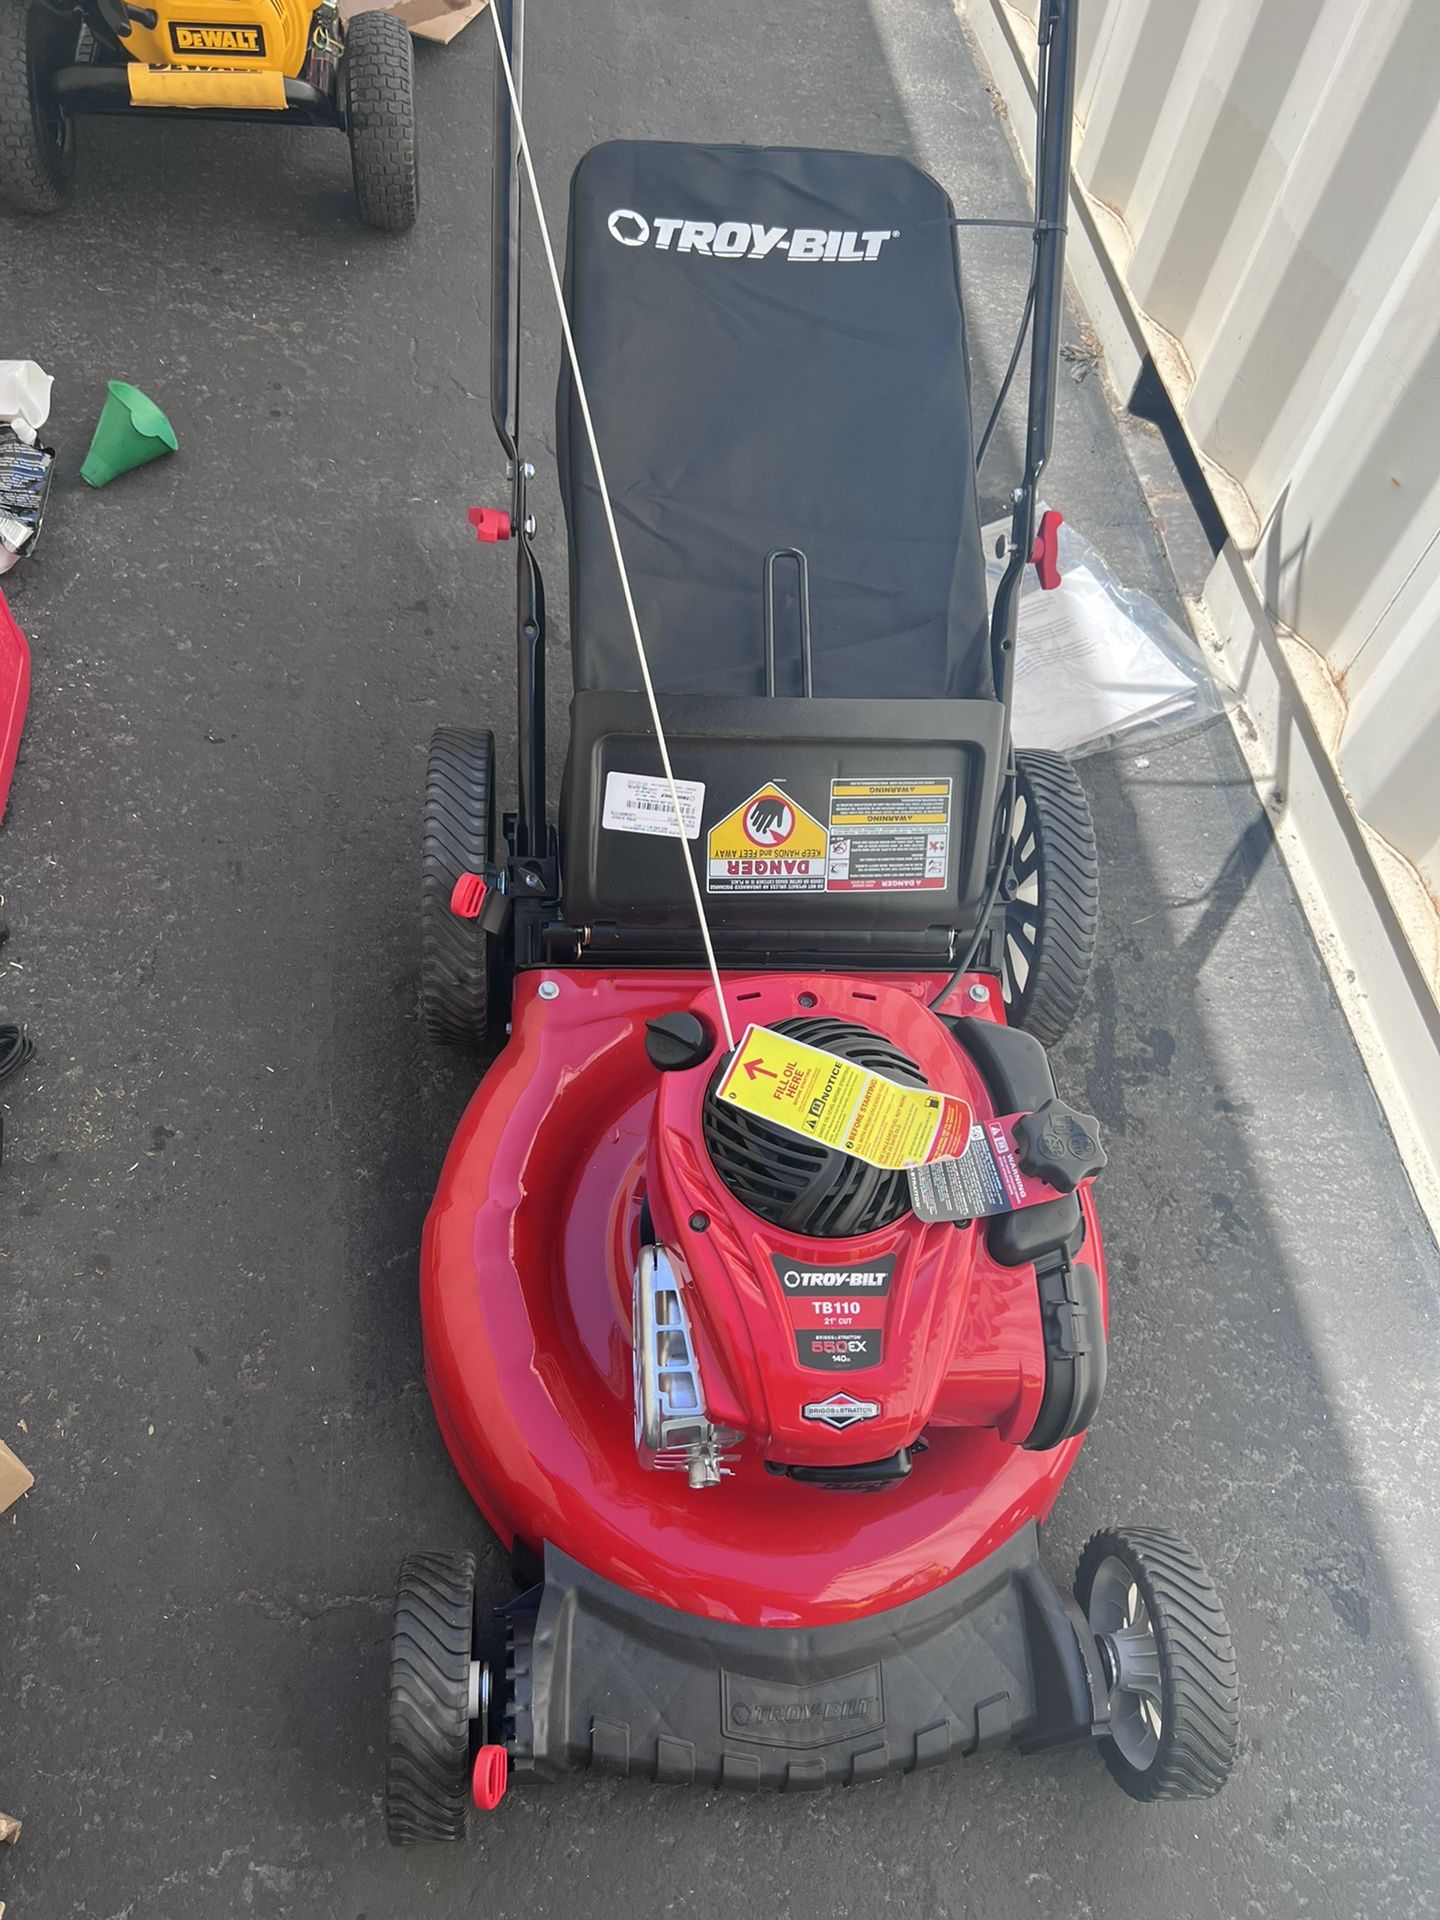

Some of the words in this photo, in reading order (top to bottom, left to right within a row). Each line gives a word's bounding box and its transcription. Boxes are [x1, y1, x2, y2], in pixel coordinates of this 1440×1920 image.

[727, 860, 809, 874] DANGER
[773, 1079, 789, 1100] FILL
[783, 1061, 797, 1078] OIL
[785, 1069, 804, 1098] HERE
[820, 1061, 842, 1101] NOTICE
[849, 1114, 864, 1141] BEFORE
[1007, 1153, 1026, 1198] WARNING
[801, 1273, 886, 1287] TROY-BILT
[812, 1302, 861, 1314] TB110
[838, 1317, 853, 1325] CUT
